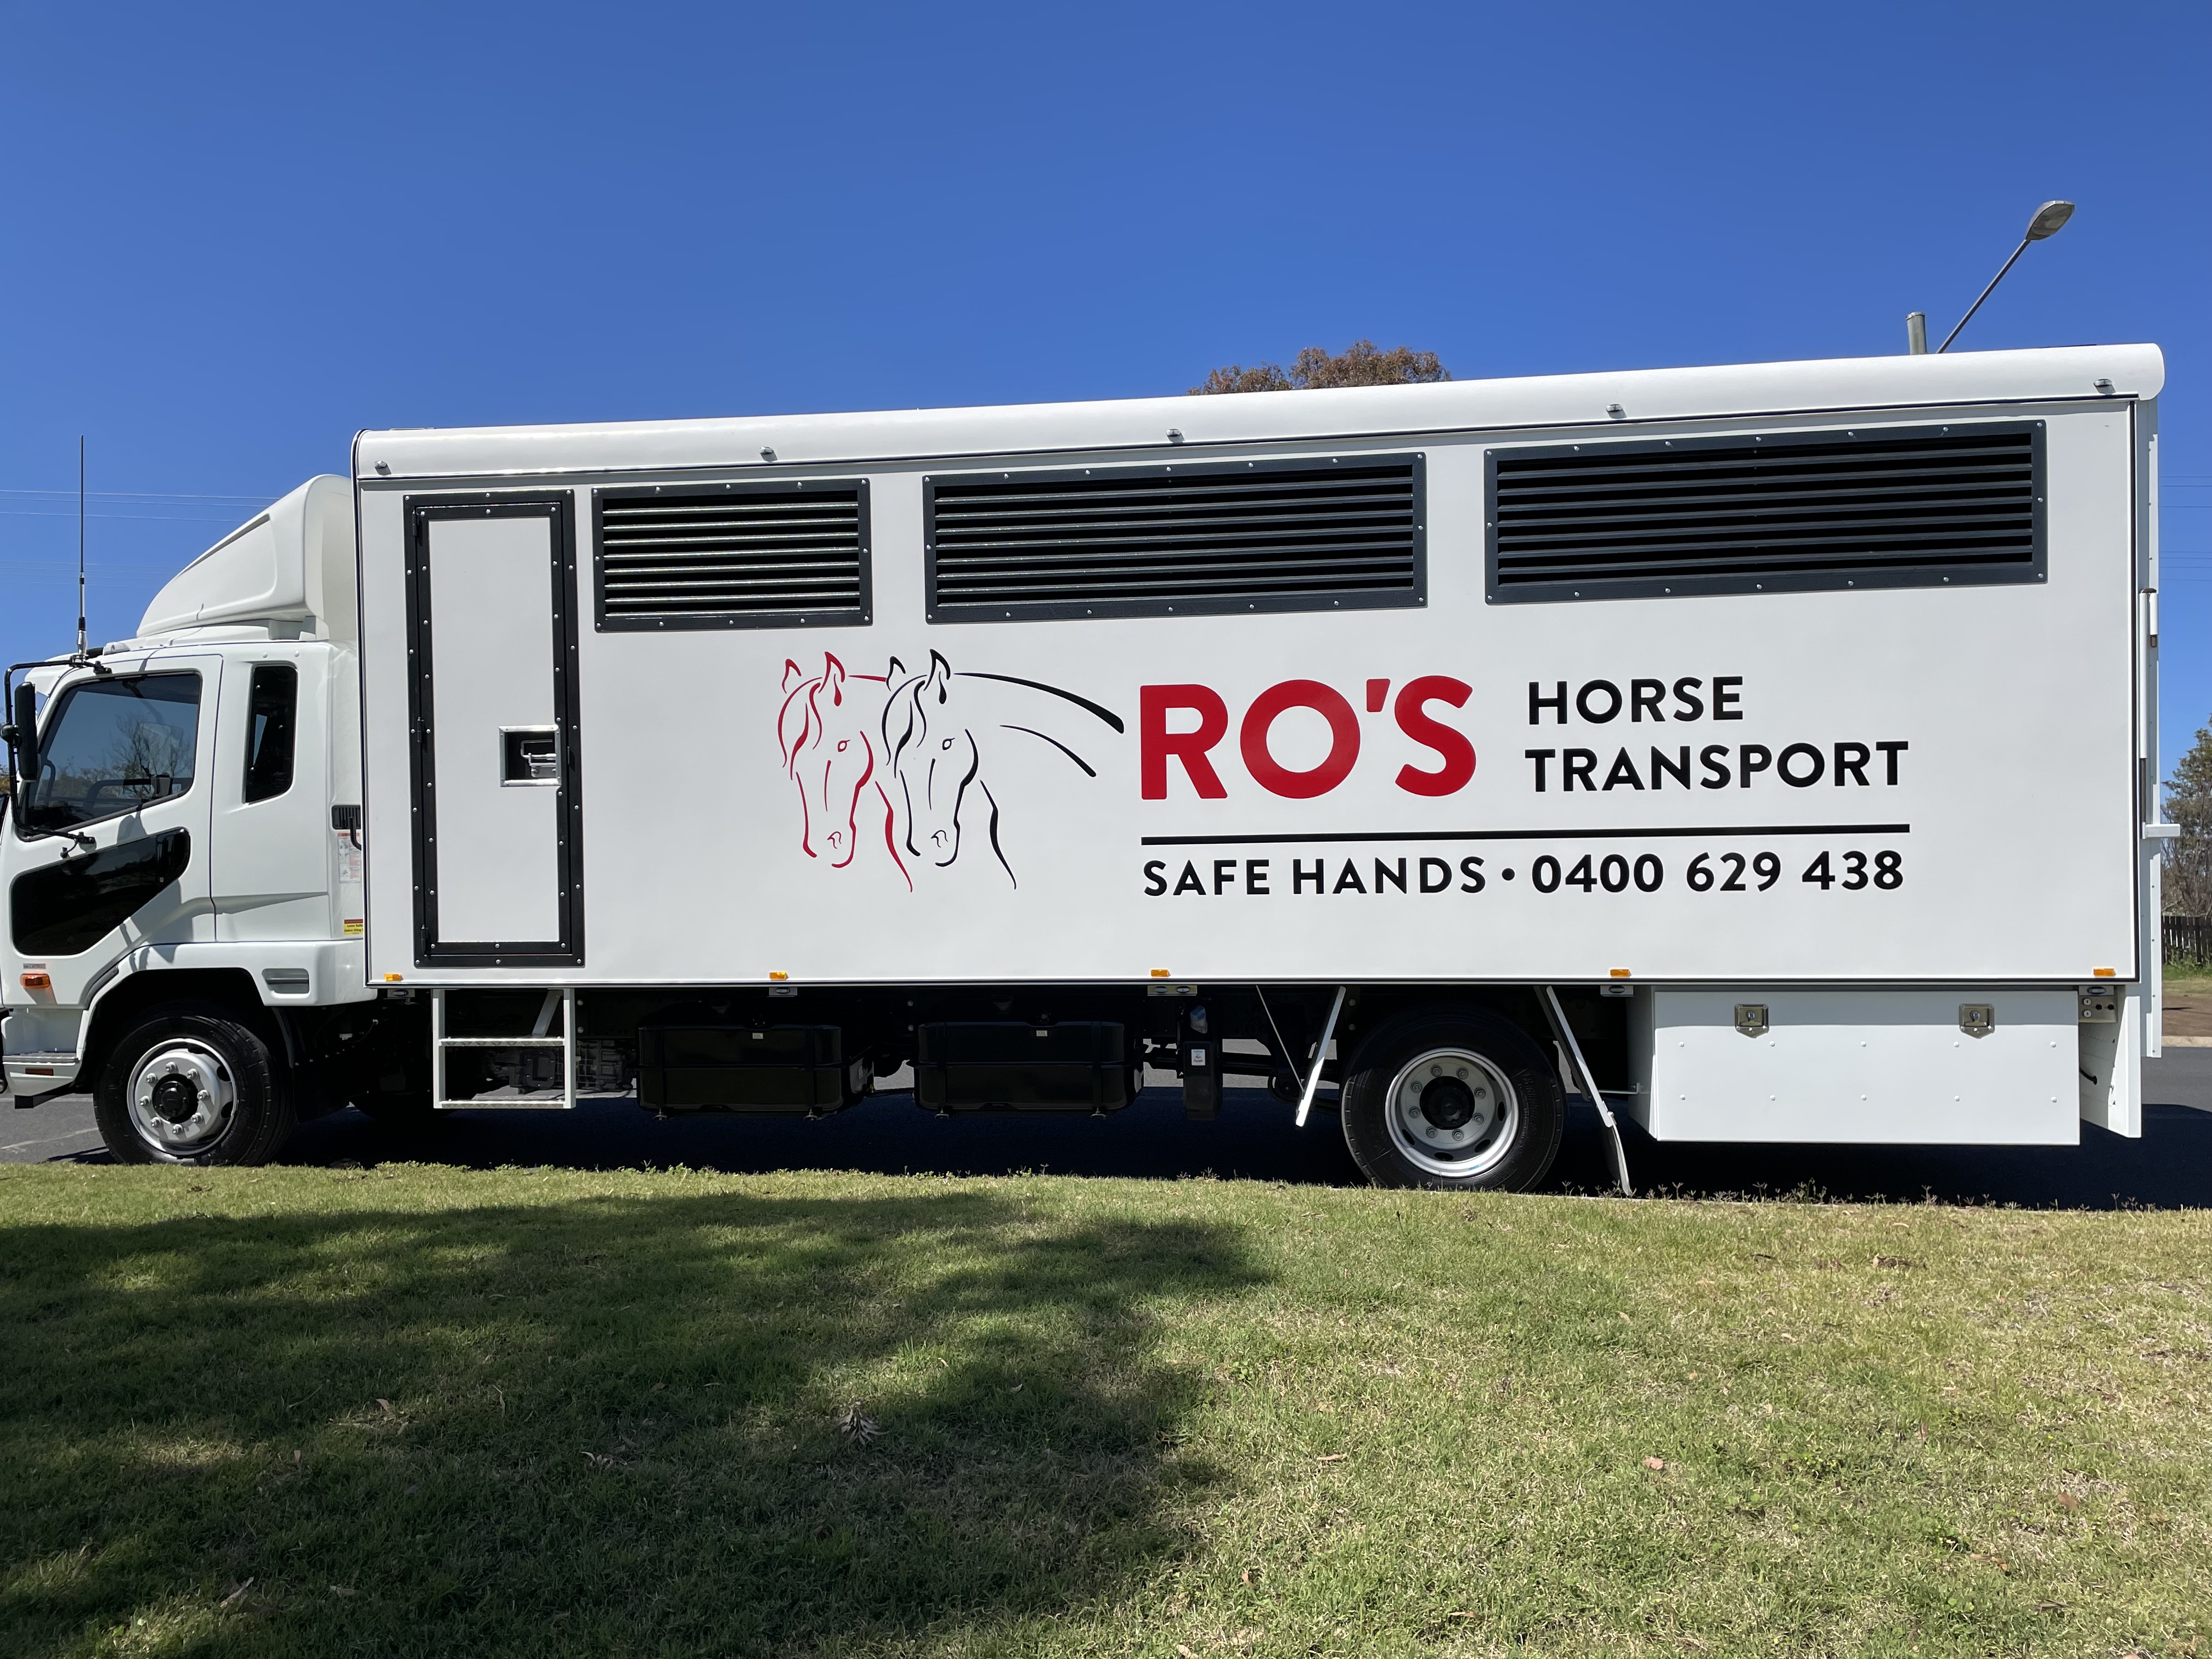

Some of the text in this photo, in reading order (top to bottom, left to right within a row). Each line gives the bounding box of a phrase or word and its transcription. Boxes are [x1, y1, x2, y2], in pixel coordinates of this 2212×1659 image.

[1528, 676, 1743, 725] HORSE
[1140, 675, 1476, 800] RO'S
[1525, 741, 1909, 792] TRANSPORT
[1143, 850, 1903, 896] SAFE HANDS 0400 629 438
